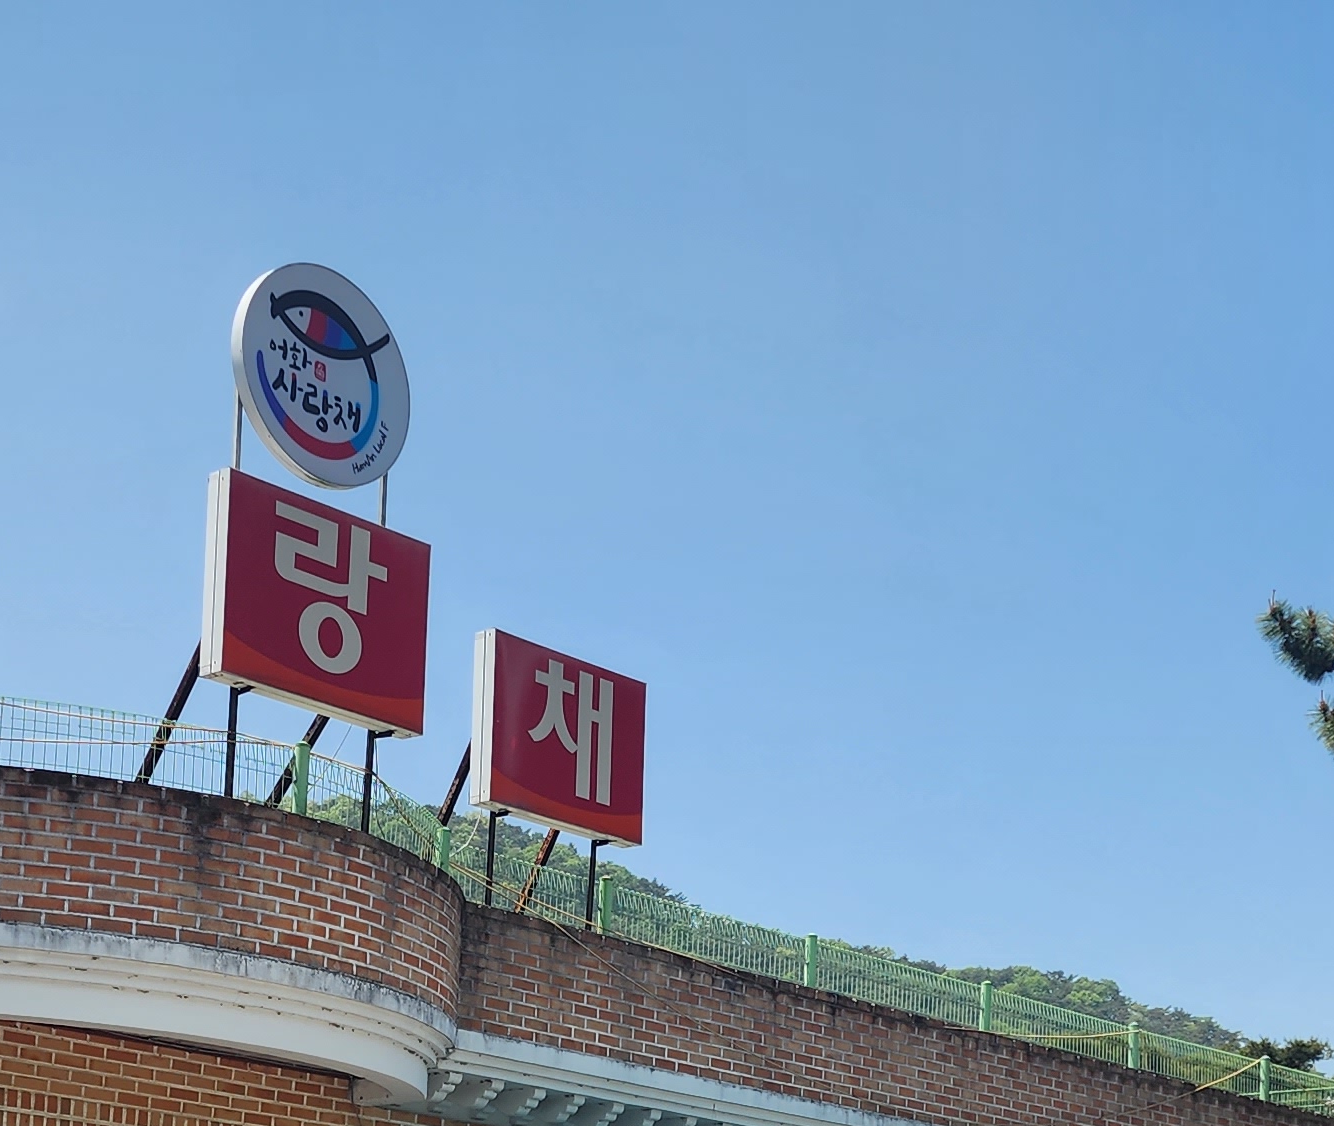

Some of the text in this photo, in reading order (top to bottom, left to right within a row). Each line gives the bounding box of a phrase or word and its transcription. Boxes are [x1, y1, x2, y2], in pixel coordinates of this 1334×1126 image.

[272, 368, 361, 433] 사랑채
[274, 500, 387, 675] 랑
[529, 660, 612, 806] 채
